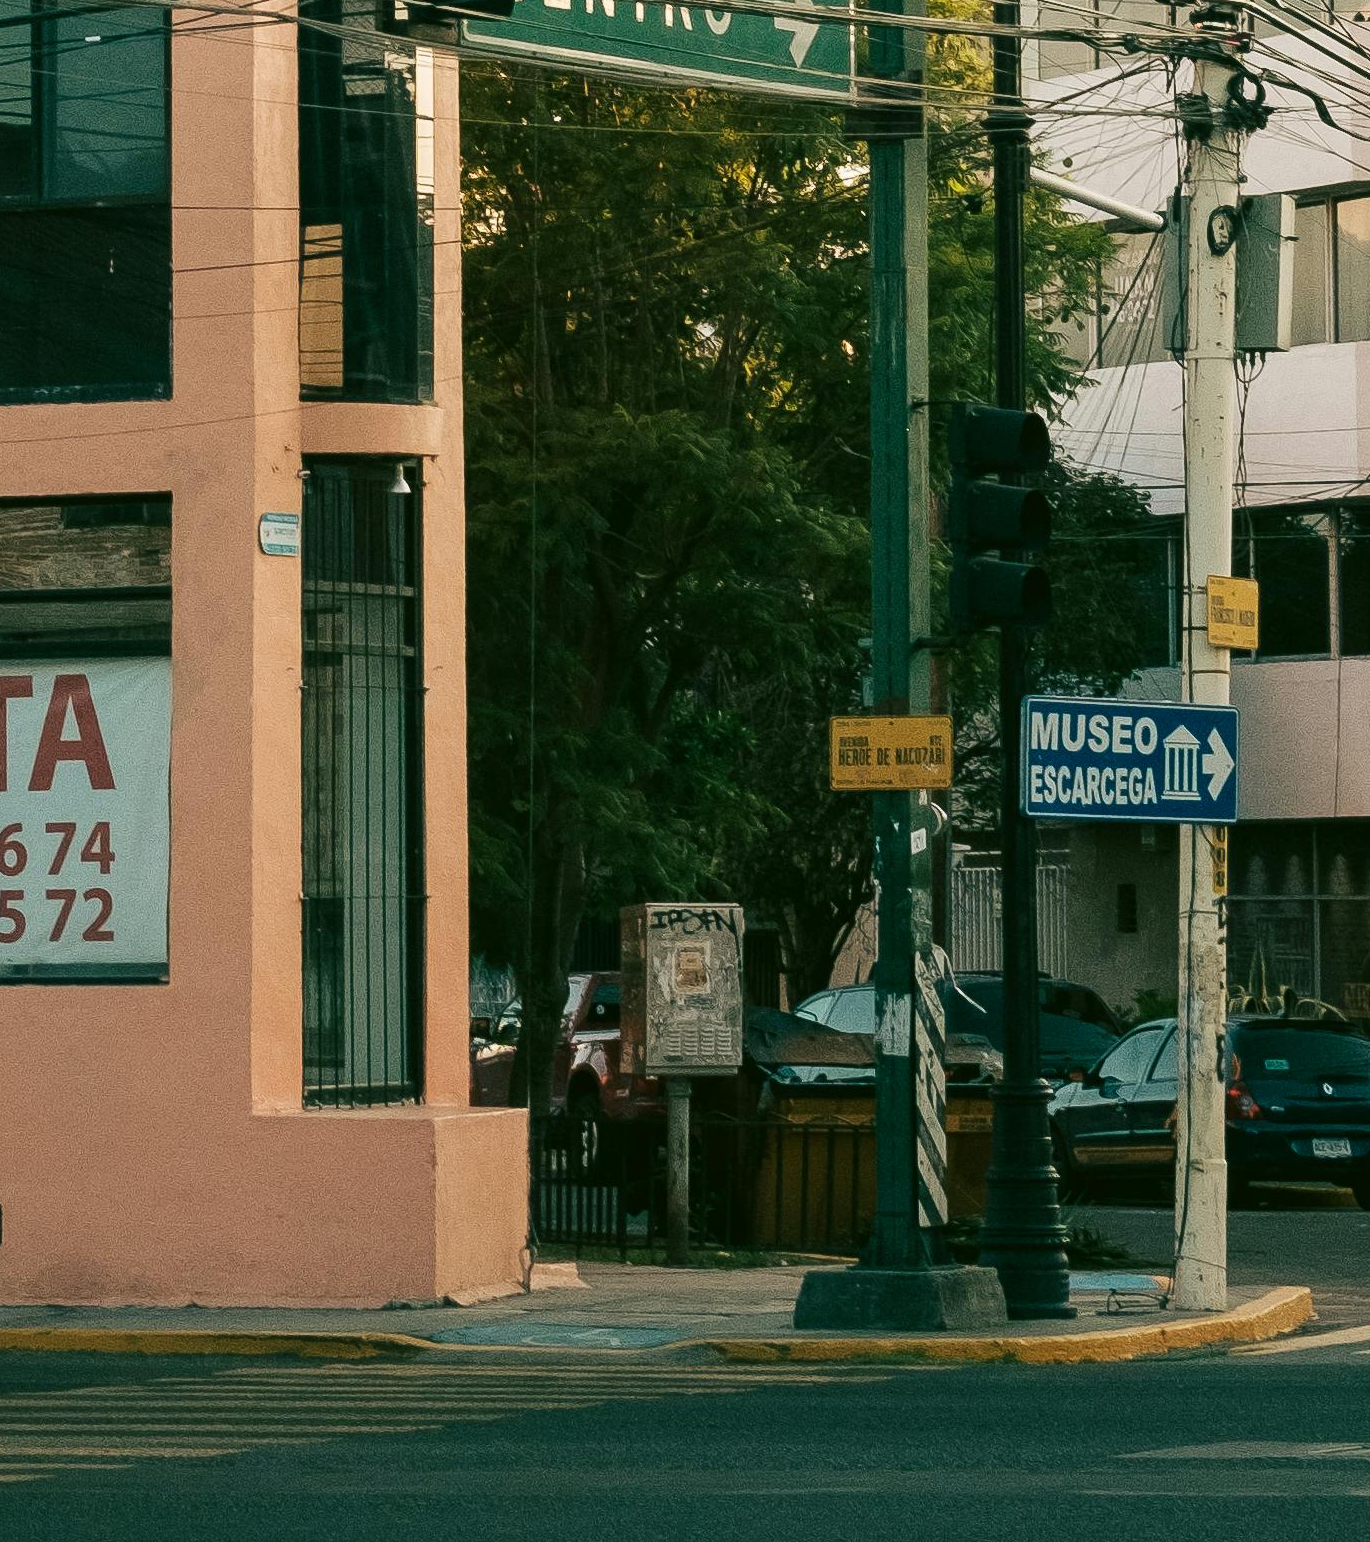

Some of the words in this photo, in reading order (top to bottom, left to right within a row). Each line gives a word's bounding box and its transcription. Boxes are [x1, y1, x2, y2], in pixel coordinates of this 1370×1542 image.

[1031, 712, 1158, 756] MUSEO
[838, 748, 872, 767] HEROE
[877, 748, 892, 766] DE
[895, 747, 945, 766] NACOZARI
[1031, 765, 1158, 805] ESCARCEGA
[45, 822, 116, 876] 74
[45, 888, 115, 943] 72
